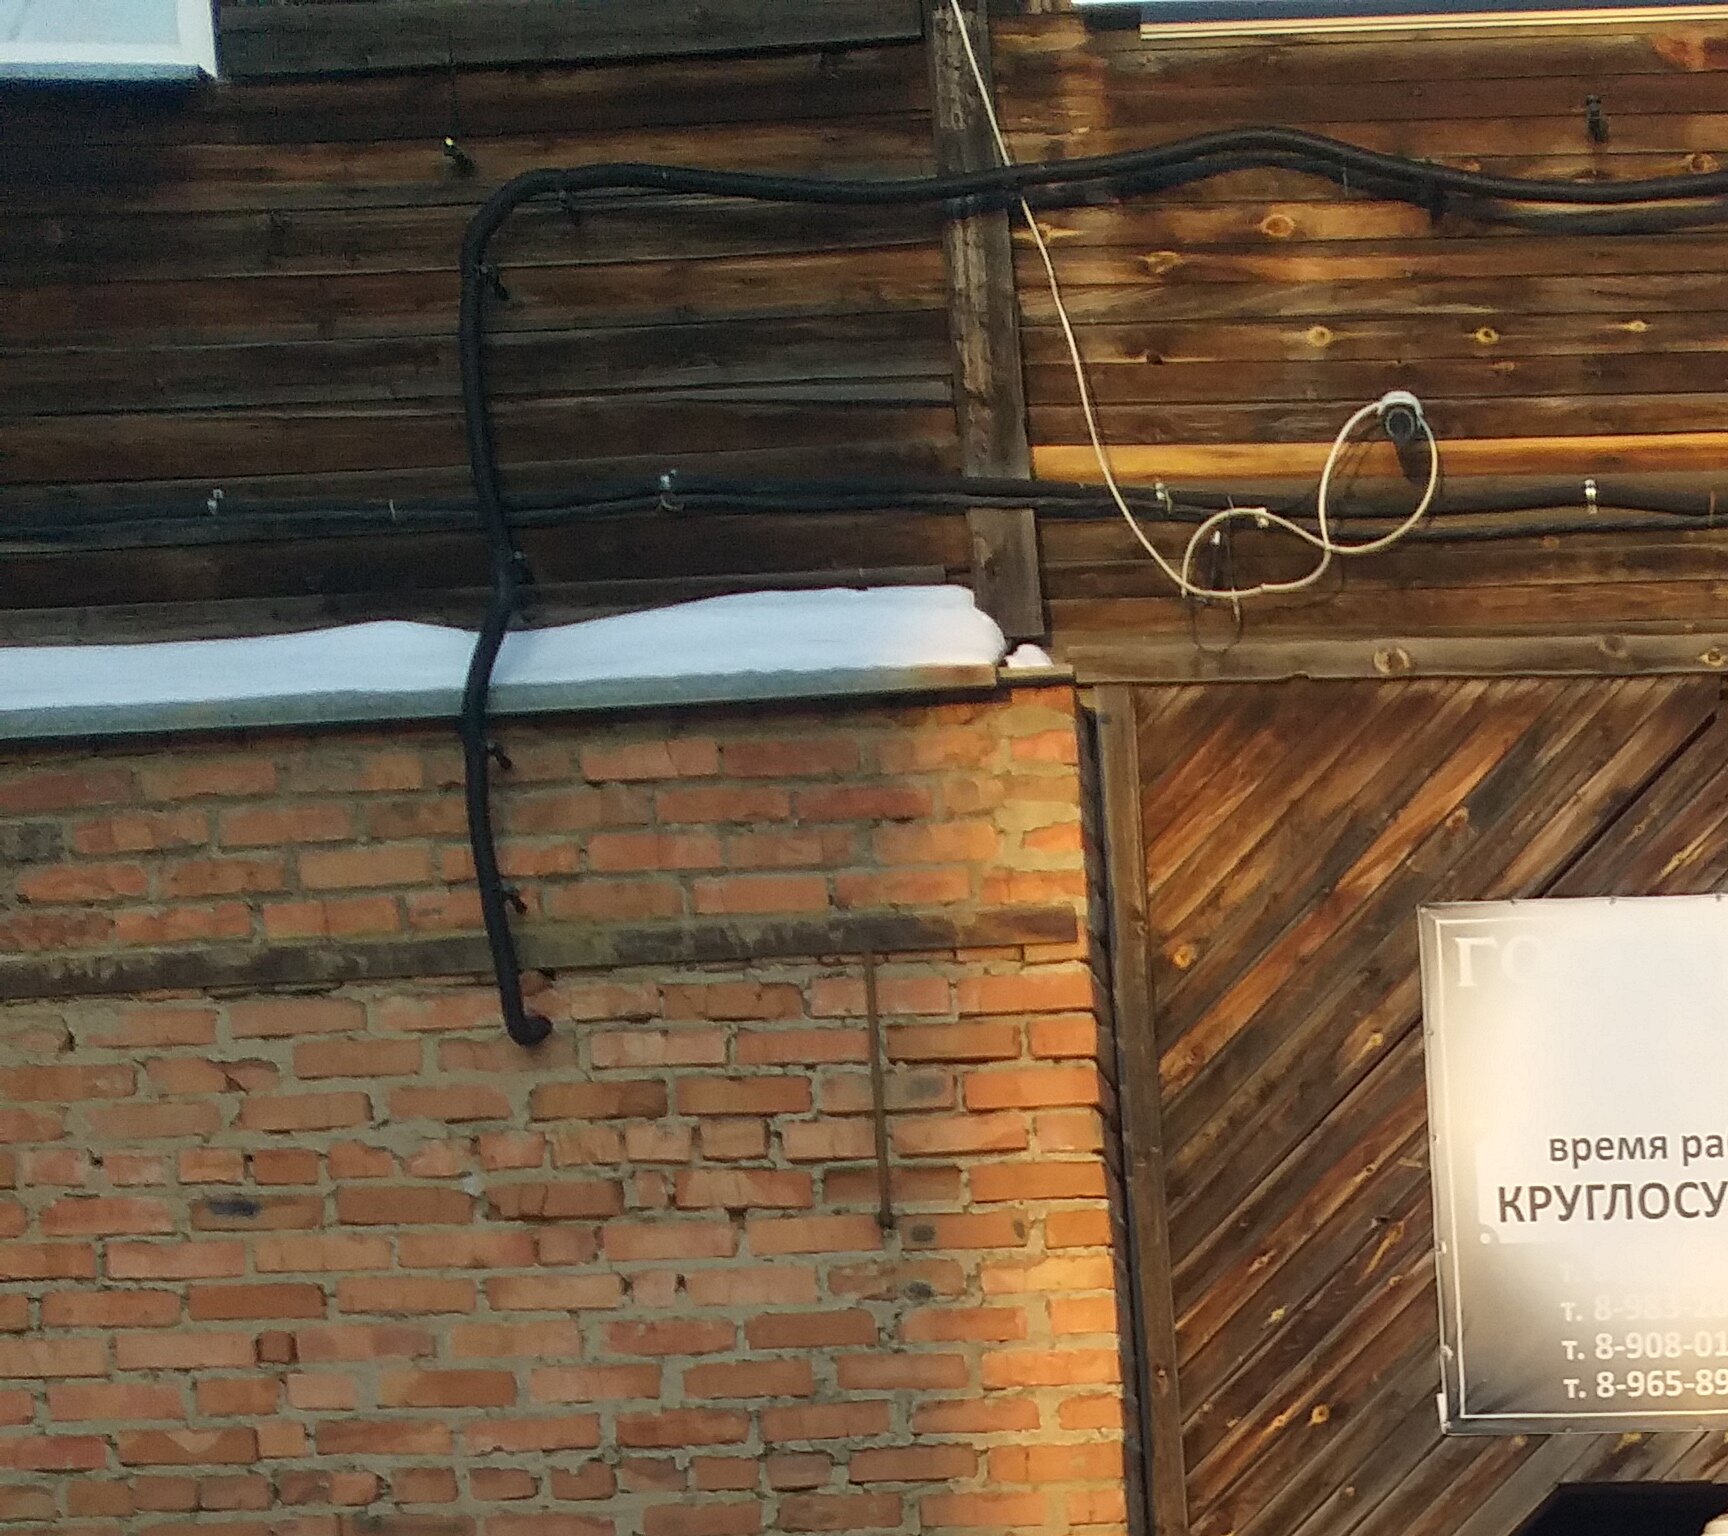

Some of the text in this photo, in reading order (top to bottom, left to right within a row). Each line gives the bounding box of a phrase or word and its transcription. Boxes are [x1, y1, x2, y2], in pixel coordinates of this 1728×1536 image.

[1549, 1131, 1668, 1169] время
[1561, 1340, 1585, 1360] т.
[1563, 1378, 1587, 1398] т.
